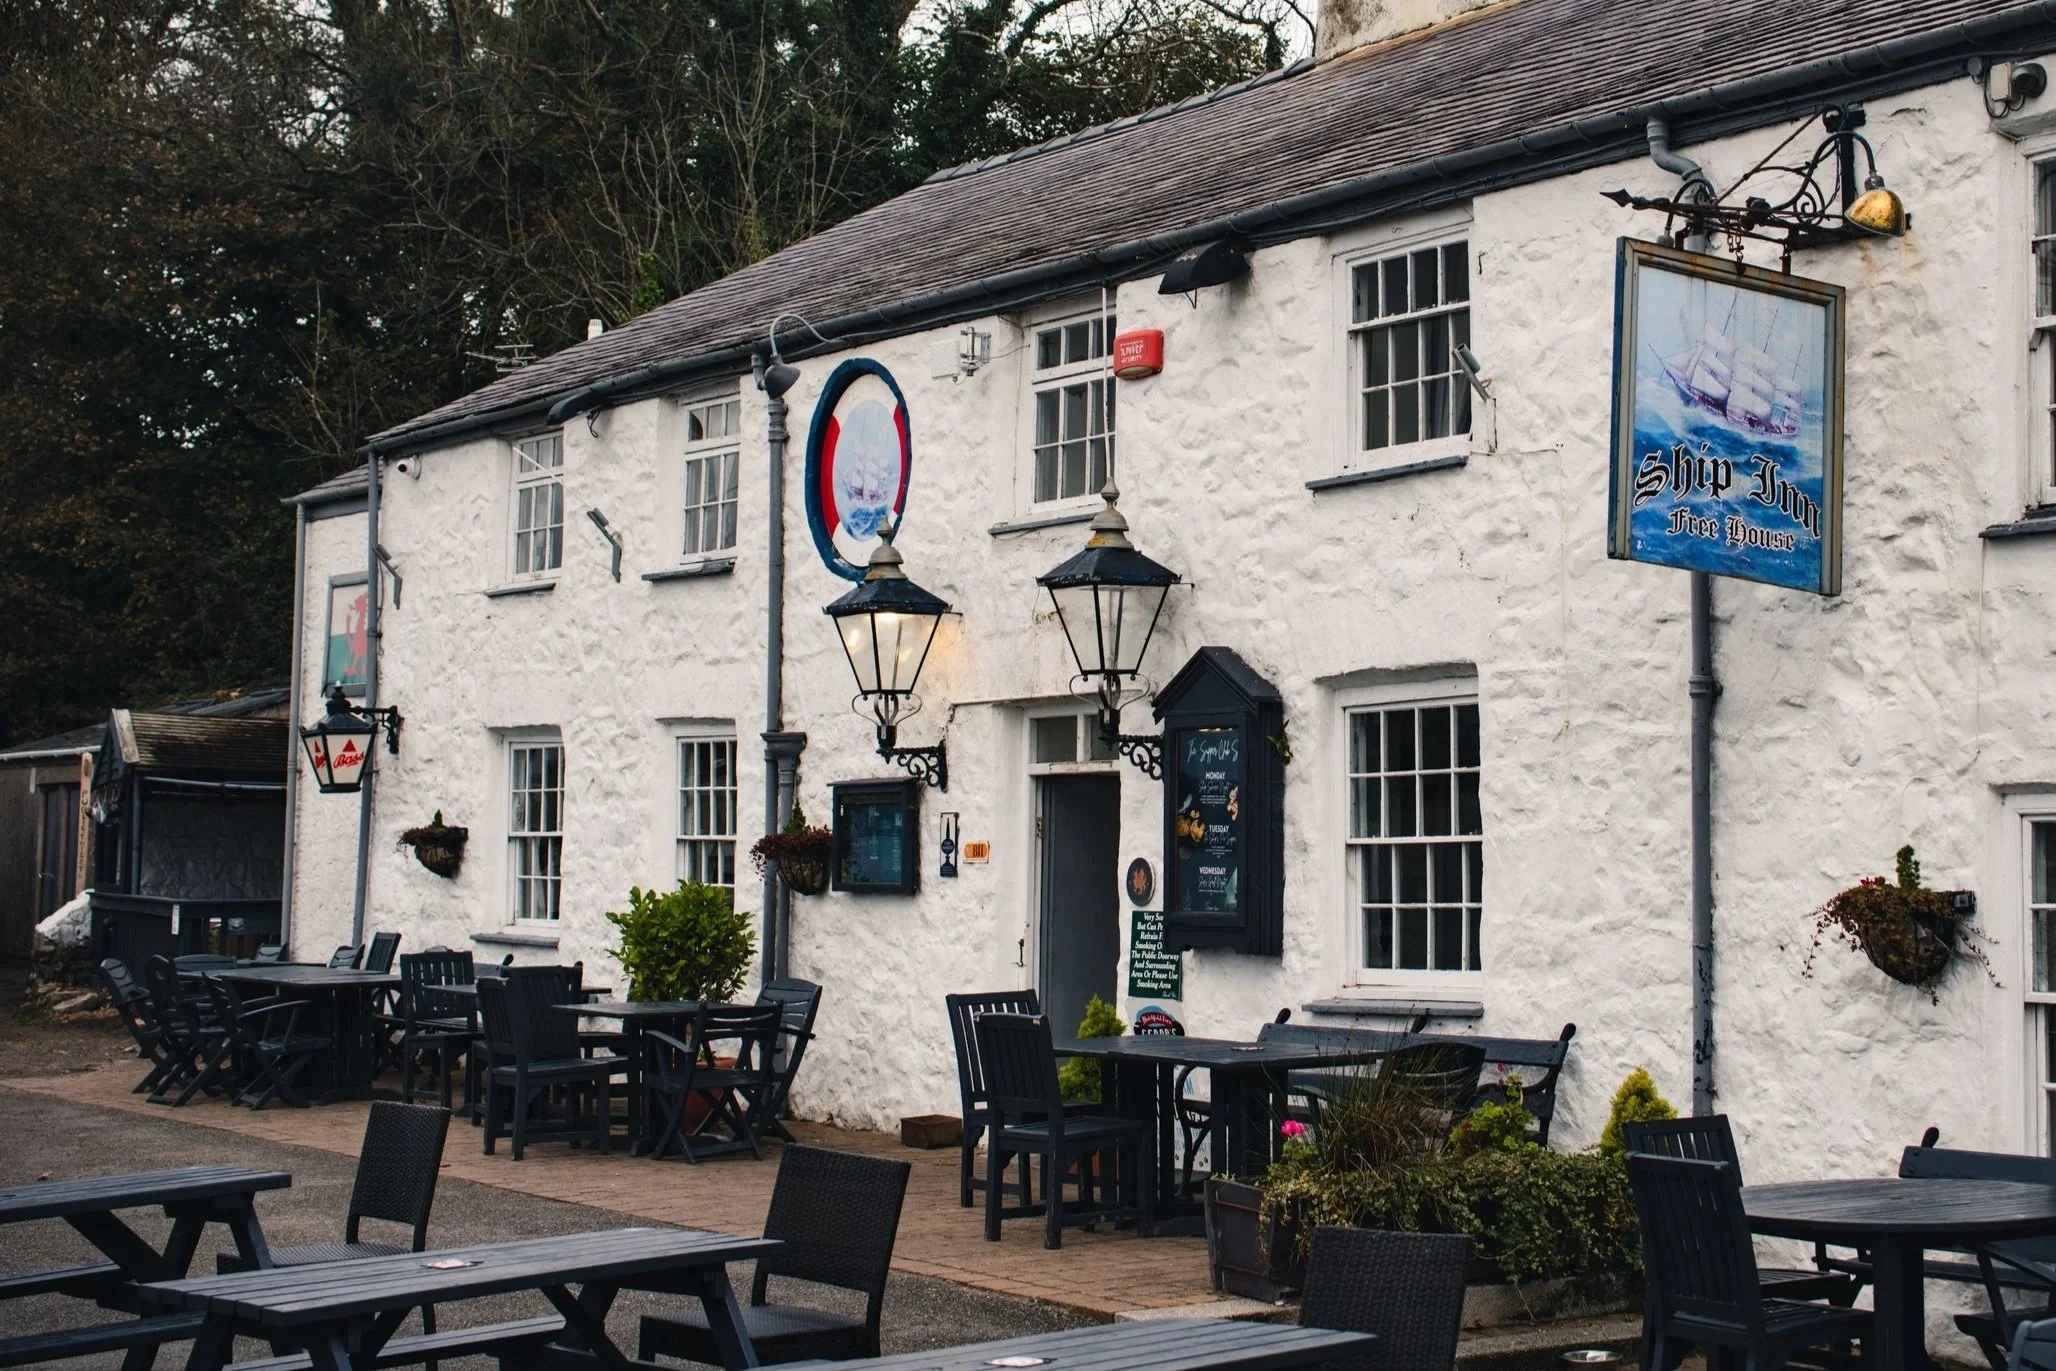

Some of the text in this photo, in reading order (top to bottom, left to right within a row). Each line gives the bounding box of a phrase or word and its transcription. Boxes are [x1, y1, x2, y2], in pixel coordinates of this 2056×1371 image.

[1634, 442, 1821, 539] Ship Inn
[1667, 507, 1795, 553] Free House
[333, 751, 365, 768] Bass
[1205, 771, 1226, 779] MONDAY
[1144, 912, 1155, 921] Very
[1137, 922, 1146, 930] But
[1147, 922, 1156, 930] Can
[1140, 932, 1158, 940] Refrain
[1135, 941, 1156, 950] Smoking
[1131, 950, 1179, 961] The Public Doorway
[1134, 961, 1176, 970] And Surrounding
[1131, 970, 1143, 978] Area
[1152, 971, 1168, 979] Please
[1168, 971, 1178, 979] Use
[1137, 980, 1171, 989] Smoking Area
